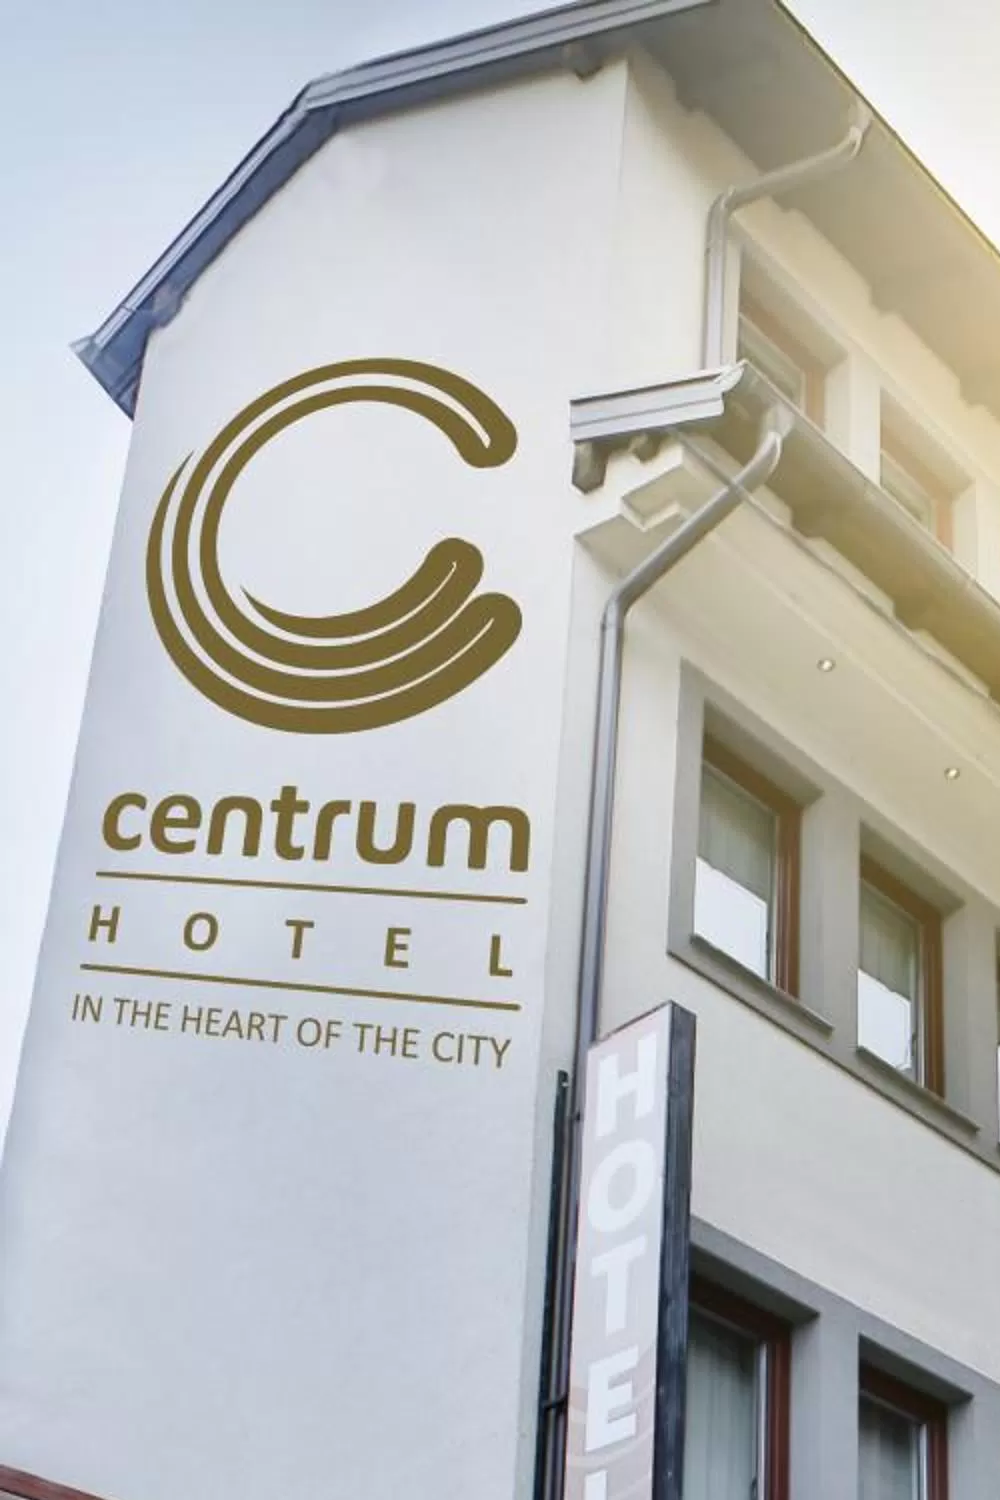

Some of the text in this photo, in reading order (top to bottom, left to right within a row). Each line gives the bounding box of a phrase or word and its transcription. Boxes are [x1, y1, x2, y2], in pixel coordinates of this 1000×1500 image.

[101, 785, 530, 872] centrum
[88, 904, 514, 978] HOTEL
[71, 993, 512, 1068] IN THE HEART OF THE CITY
